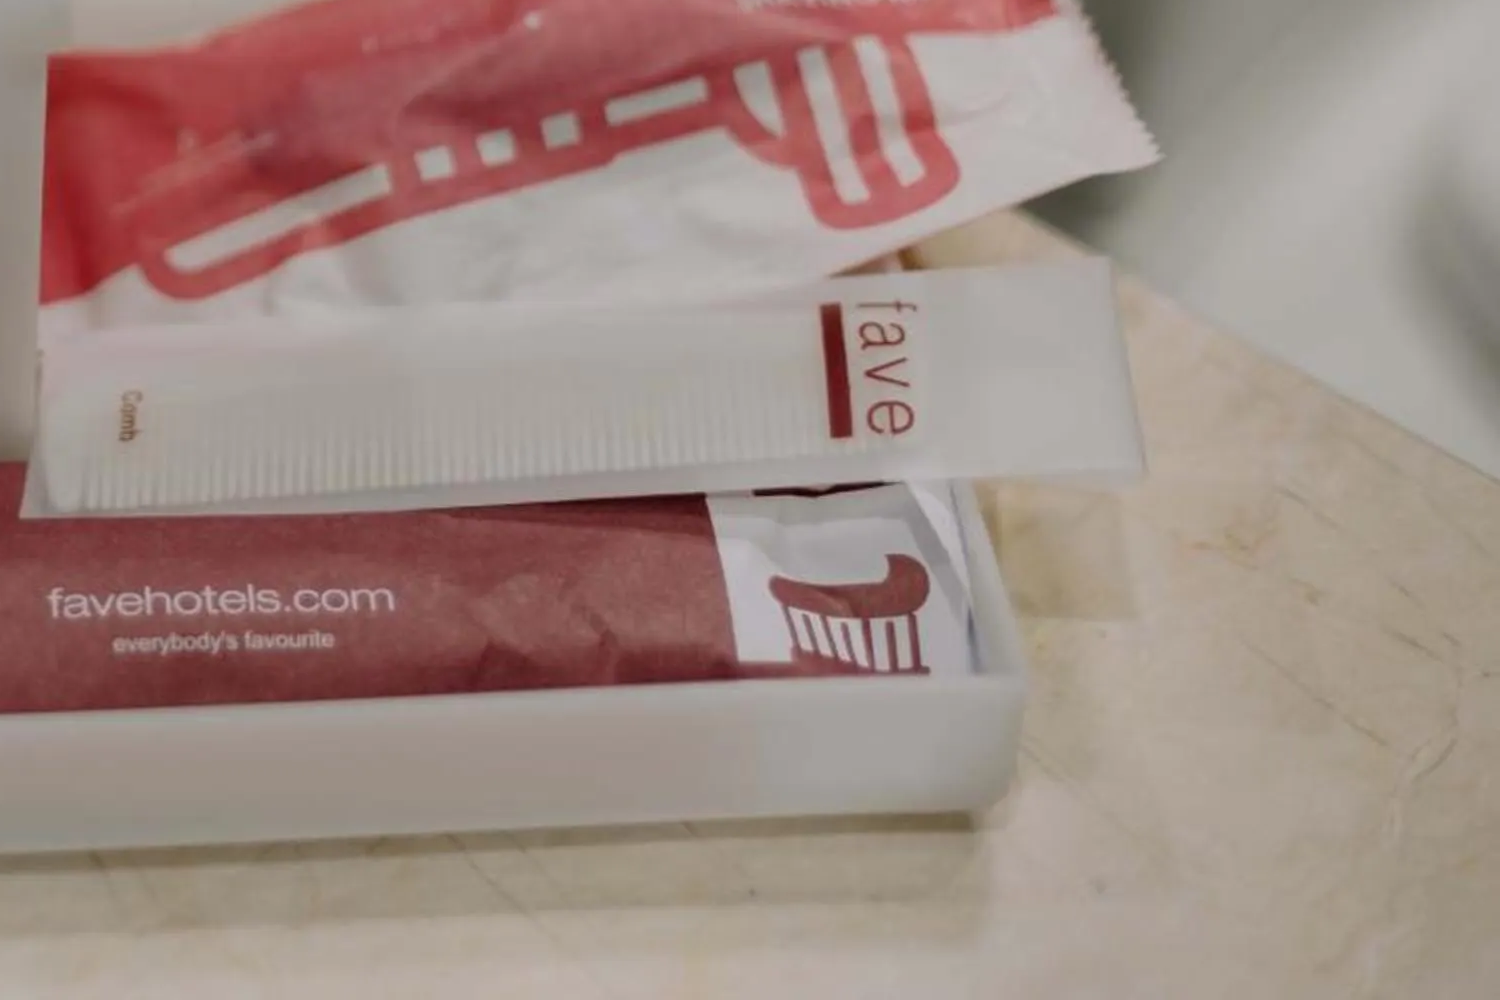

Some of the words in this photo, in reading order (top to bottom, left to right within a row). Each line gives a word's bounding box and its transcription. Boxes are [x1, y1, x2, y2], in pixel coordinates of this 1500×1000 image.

[855, 298, 919, 436] fave
[118, 389, 143, 442] Comb
[47, 583, 396, 620] favehotels.com
[111, 631, 239, 656] everybody's
[244, 629, 335, 650] favourite
